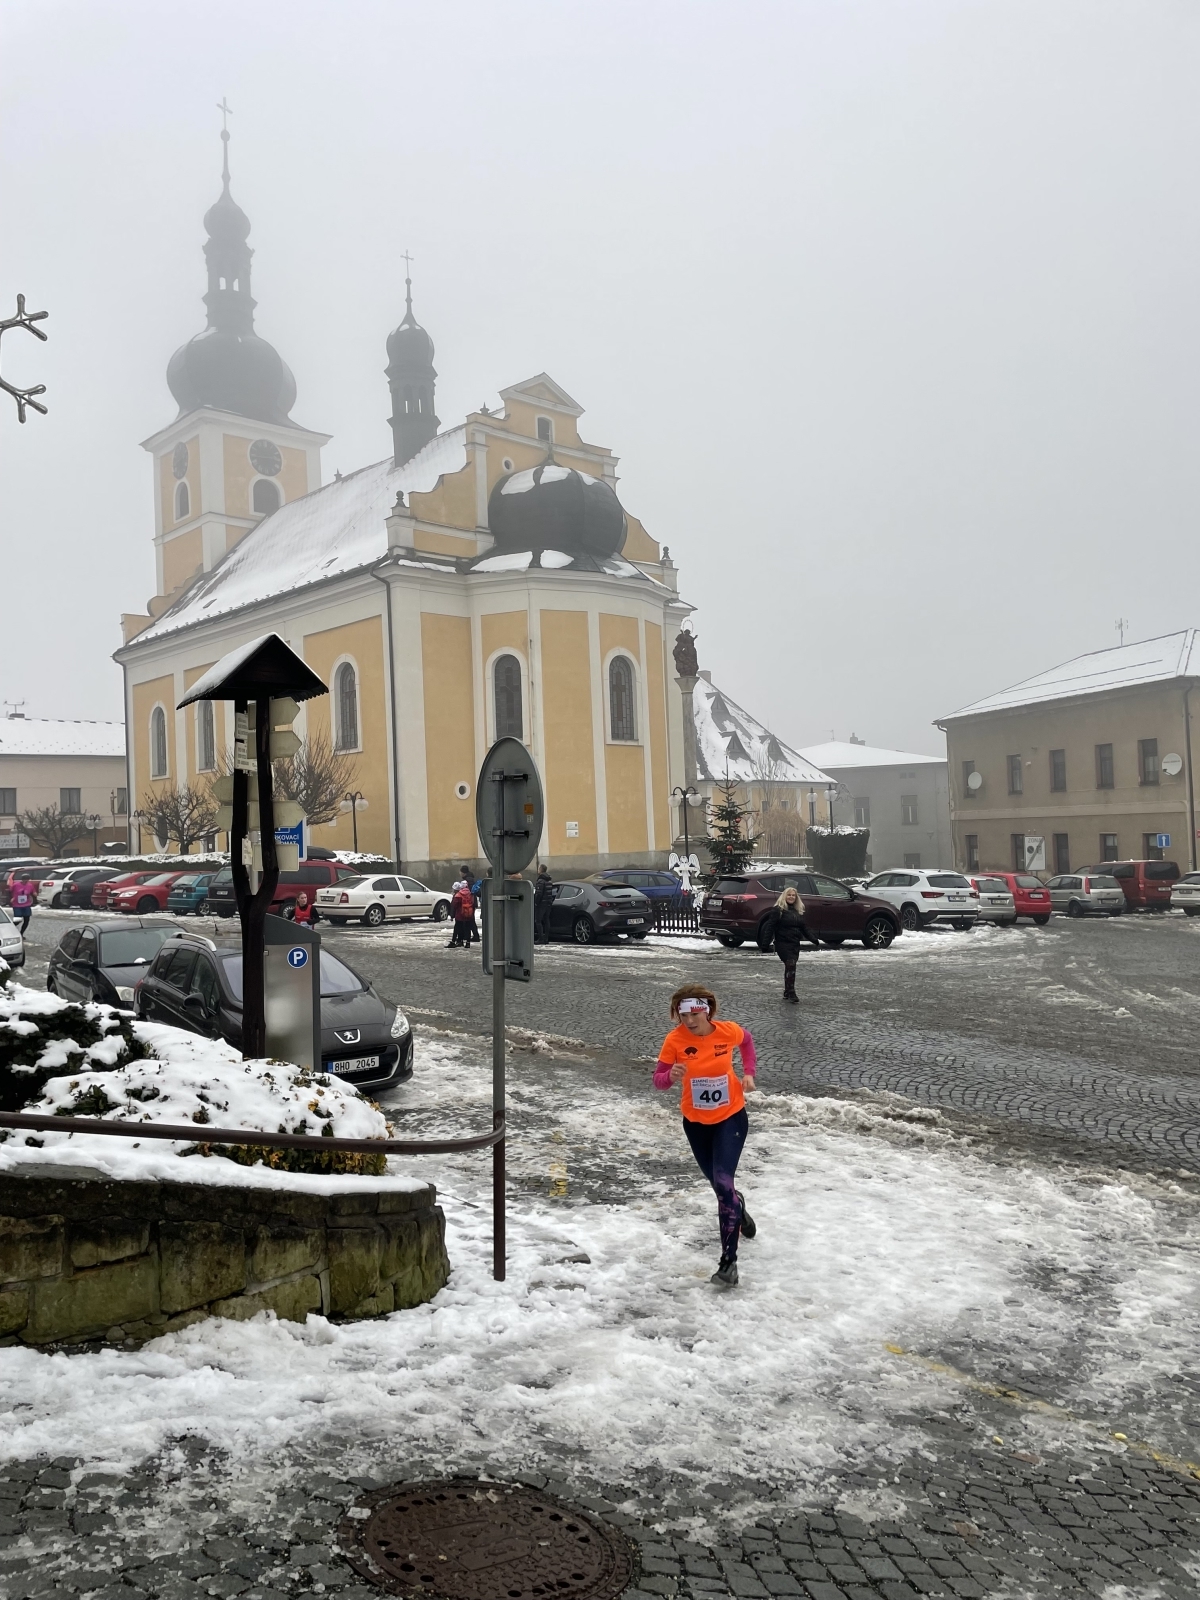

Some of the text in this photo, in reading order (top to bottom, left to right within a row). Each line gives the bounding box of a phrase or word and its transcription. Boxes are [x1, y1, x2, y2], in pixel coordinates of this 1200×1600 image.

[294, 952, 304, 964] P
[356, 1058, 376, 1068] 2045
[700, 1090, 722, 1103] 40
